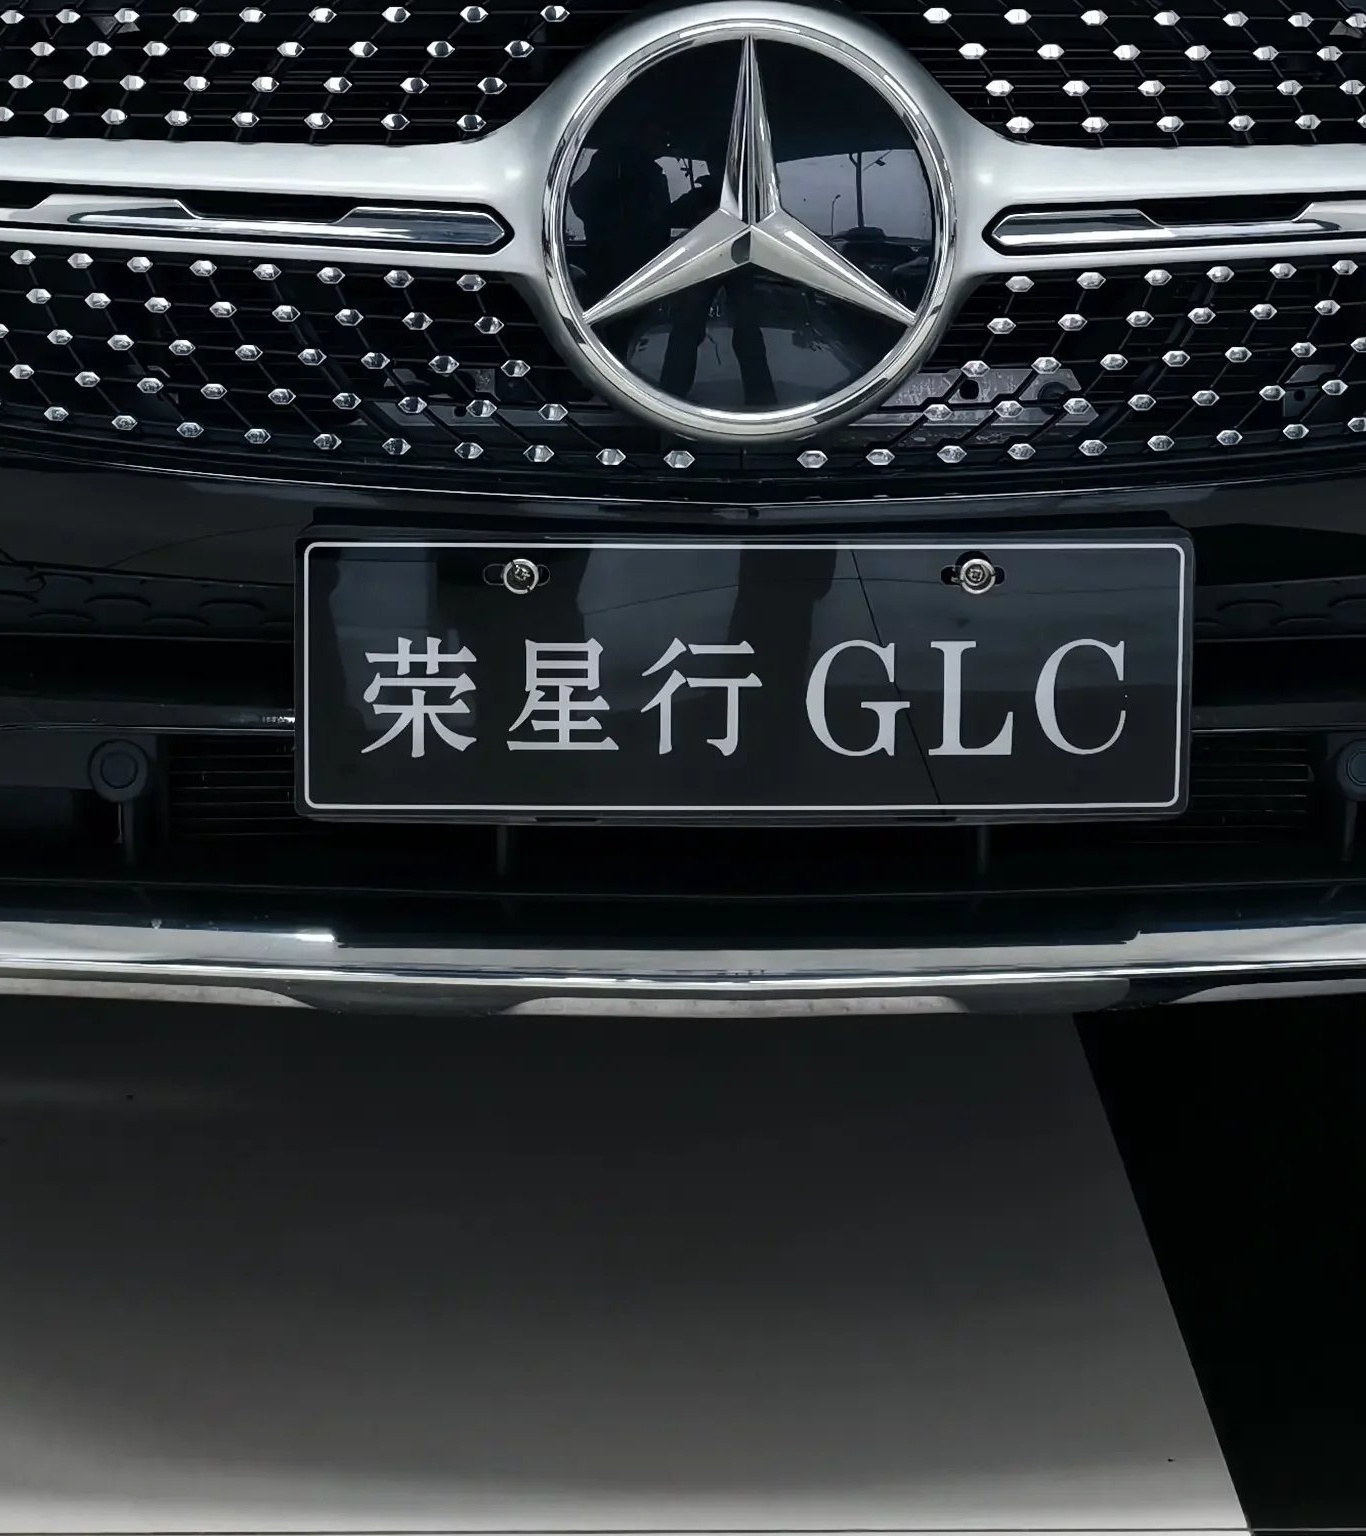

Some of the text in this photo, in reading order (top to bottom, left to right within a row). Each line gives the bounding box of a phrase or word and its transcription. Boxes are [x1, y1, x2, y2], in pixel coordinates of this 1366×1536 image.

[361, 636, 1128, 758] 荣星行 GLC
